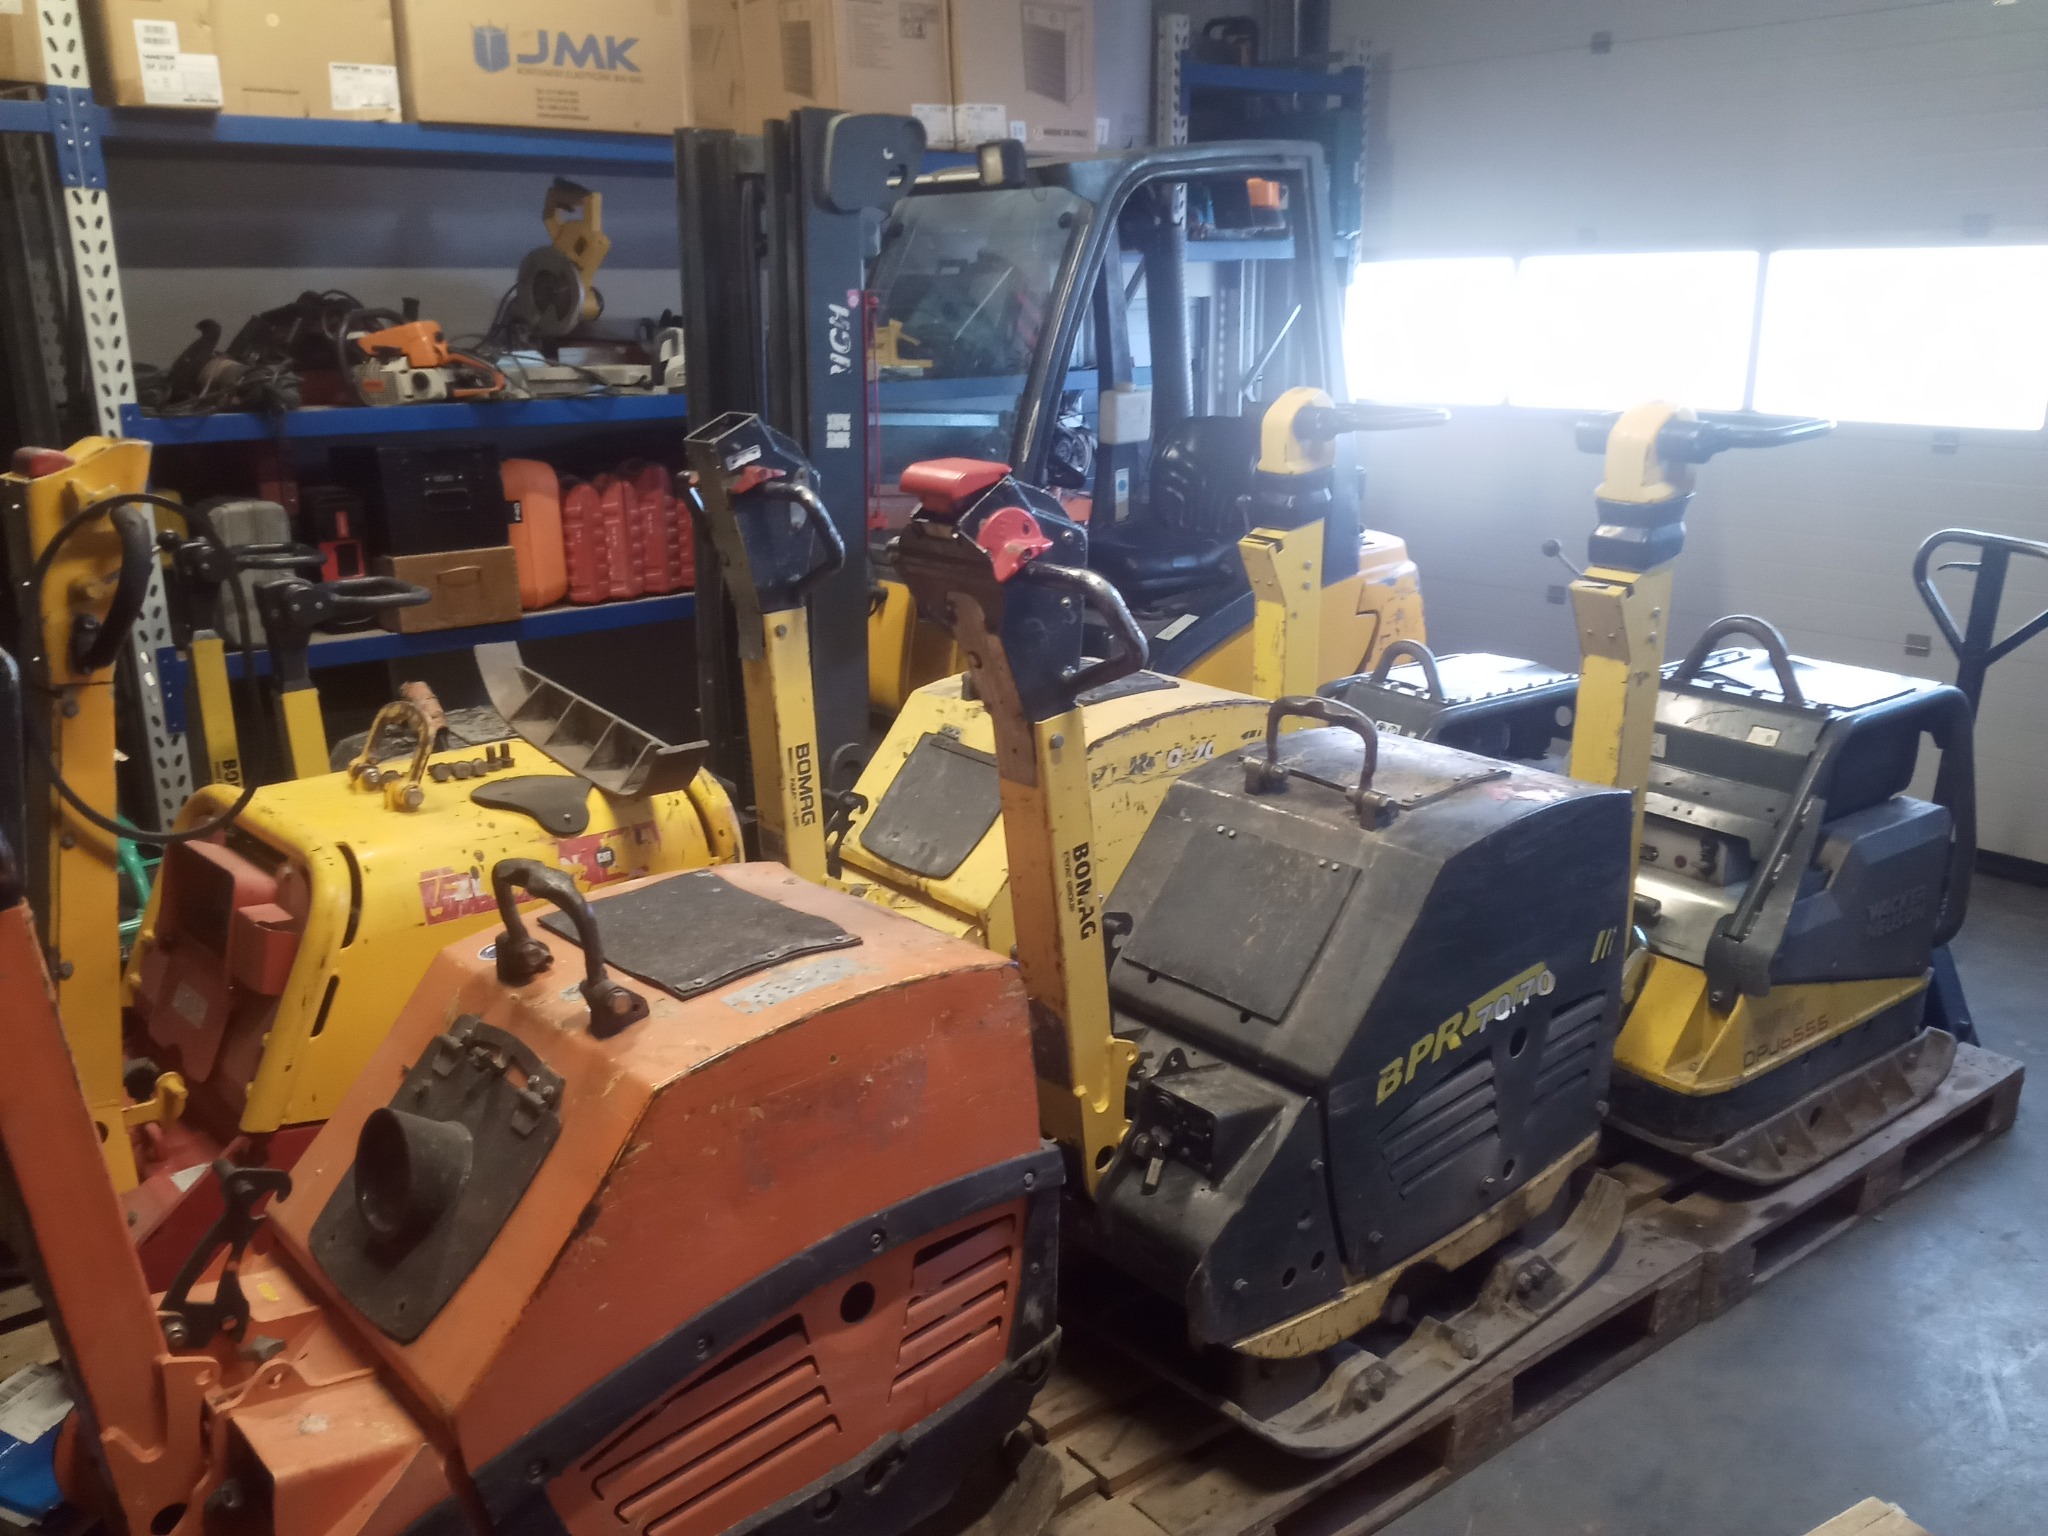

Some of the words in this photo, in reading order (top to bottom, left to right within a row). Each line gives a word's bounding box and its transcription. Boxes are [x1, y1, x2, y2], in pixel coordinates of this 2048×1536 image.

[517, 30, 642, 72] JMK
[222, 759, 241, 787] BO
[796, 743, 816, 827] BOMAG
[1376, 1011, 1464, 1106] BPR
[1476, 970, 1557, 1034] 70/70
